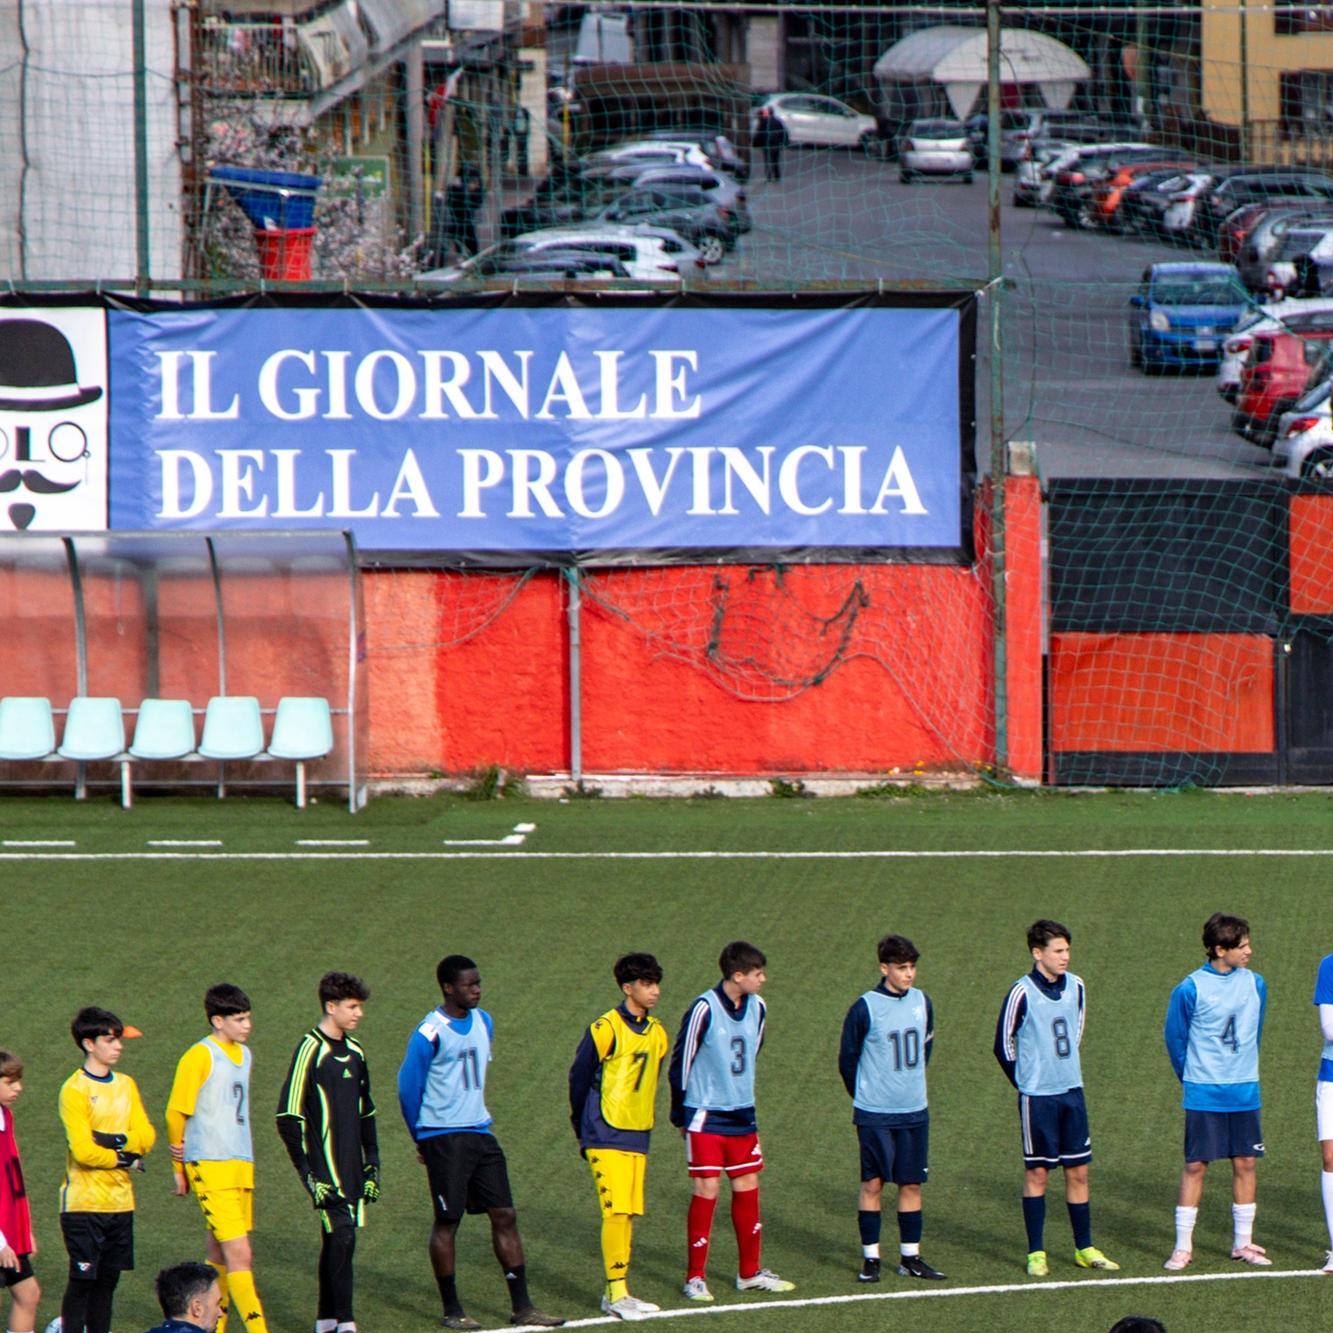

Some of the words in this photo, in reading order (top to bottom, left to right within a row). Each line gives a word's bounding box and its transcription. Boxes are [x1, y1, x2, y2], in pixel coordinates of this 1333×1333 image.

[154, 350, 240, 419] IL
[258, 349, 702, 420] GIORNALE
[154, 448, 440, 519] DELLA
[456, 445, 929, 519] PROVINCIA
[887, 1026, 919, 1072] 10
[1052, 1016, 1071, 1060] 8
[1220, 1013, 1239, 1054] 4
[457, 1047, 481, 1091] 11
[632, 1051, 649, 1093] 7
[730, 1035, 747, 1077] 3
[232, 1081, 245, 1126] 2
